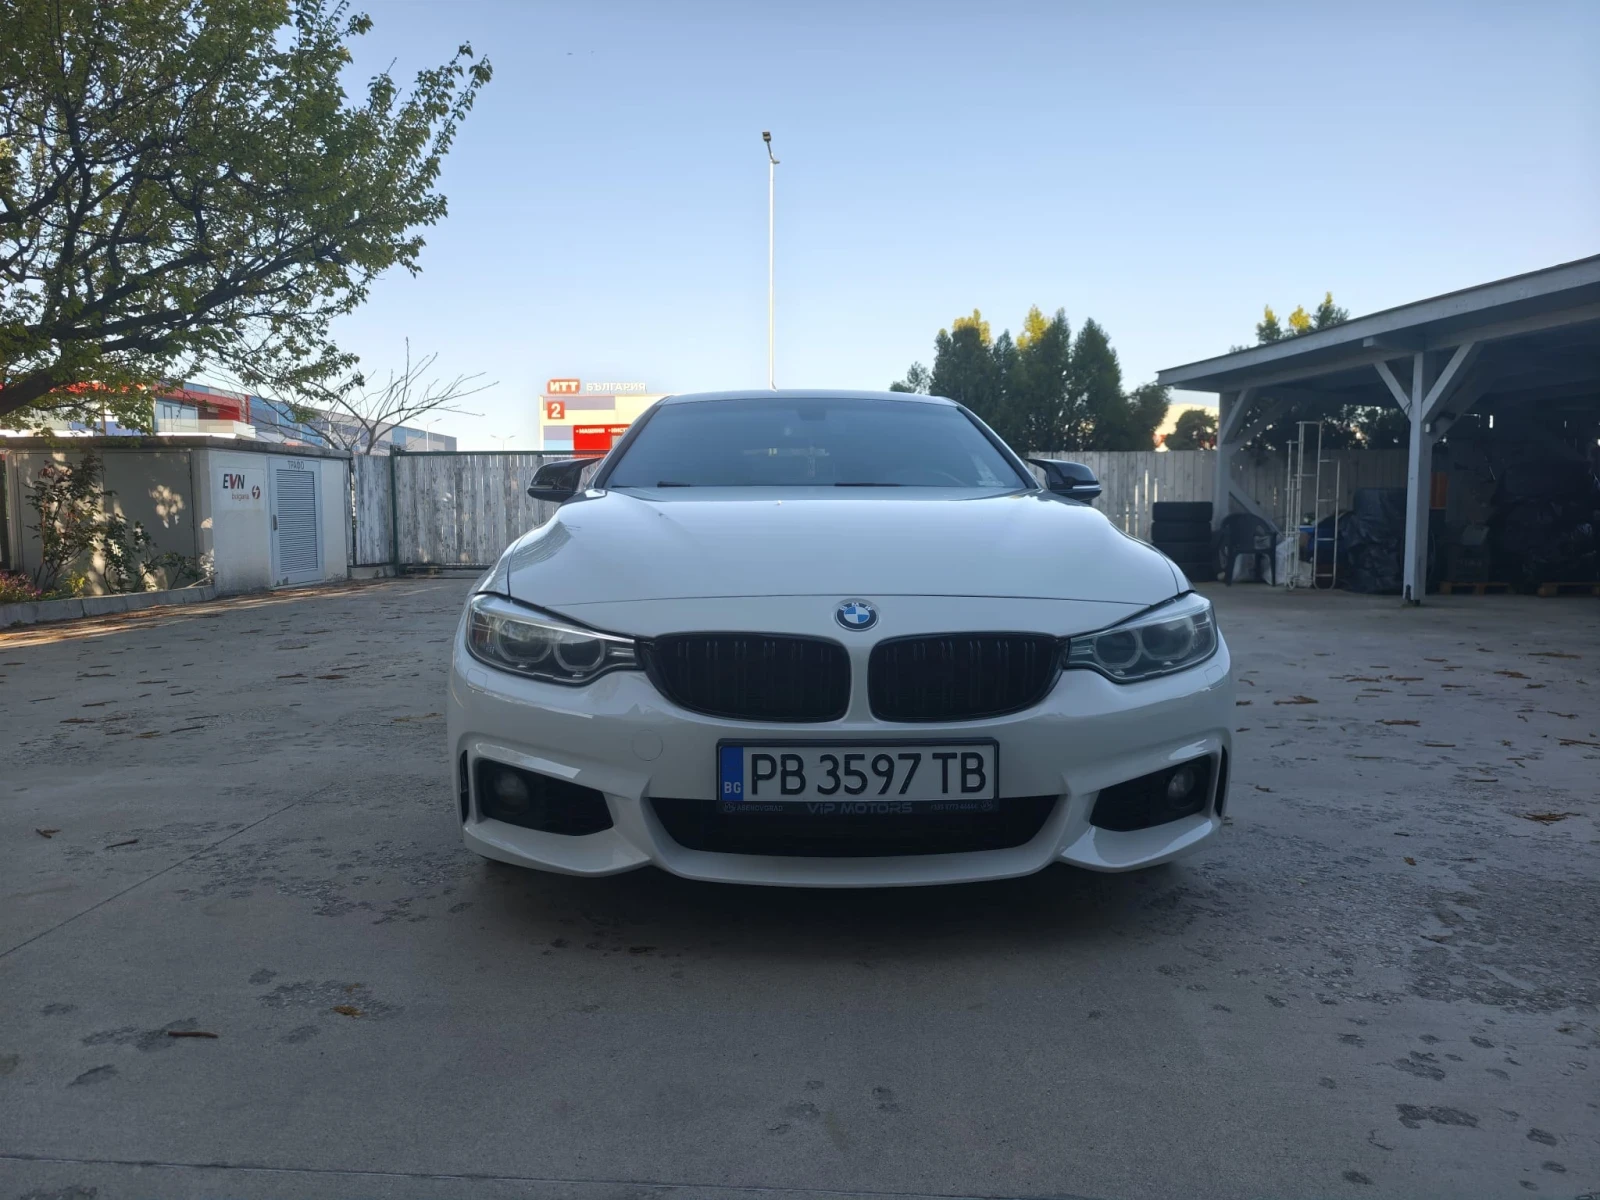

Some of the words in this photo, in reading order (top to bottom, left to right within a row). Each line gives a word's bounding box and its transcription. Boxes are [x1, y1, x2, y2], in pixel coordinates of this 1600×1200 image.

[550, 381, 578, 391] ИТТ
[586, 382, 646, 391] БЪЛГАРИЯ
[551, 403, 561, 417] 2
[222, 473, 245, 490] EVN
[751, 753, 807, 796] PB
[817, 753, 922, 795] 3597
[932, 752, 987, 794] TB
[724, 781, 741, 794] BG
[840, 802, 913, 814] MOTORS
